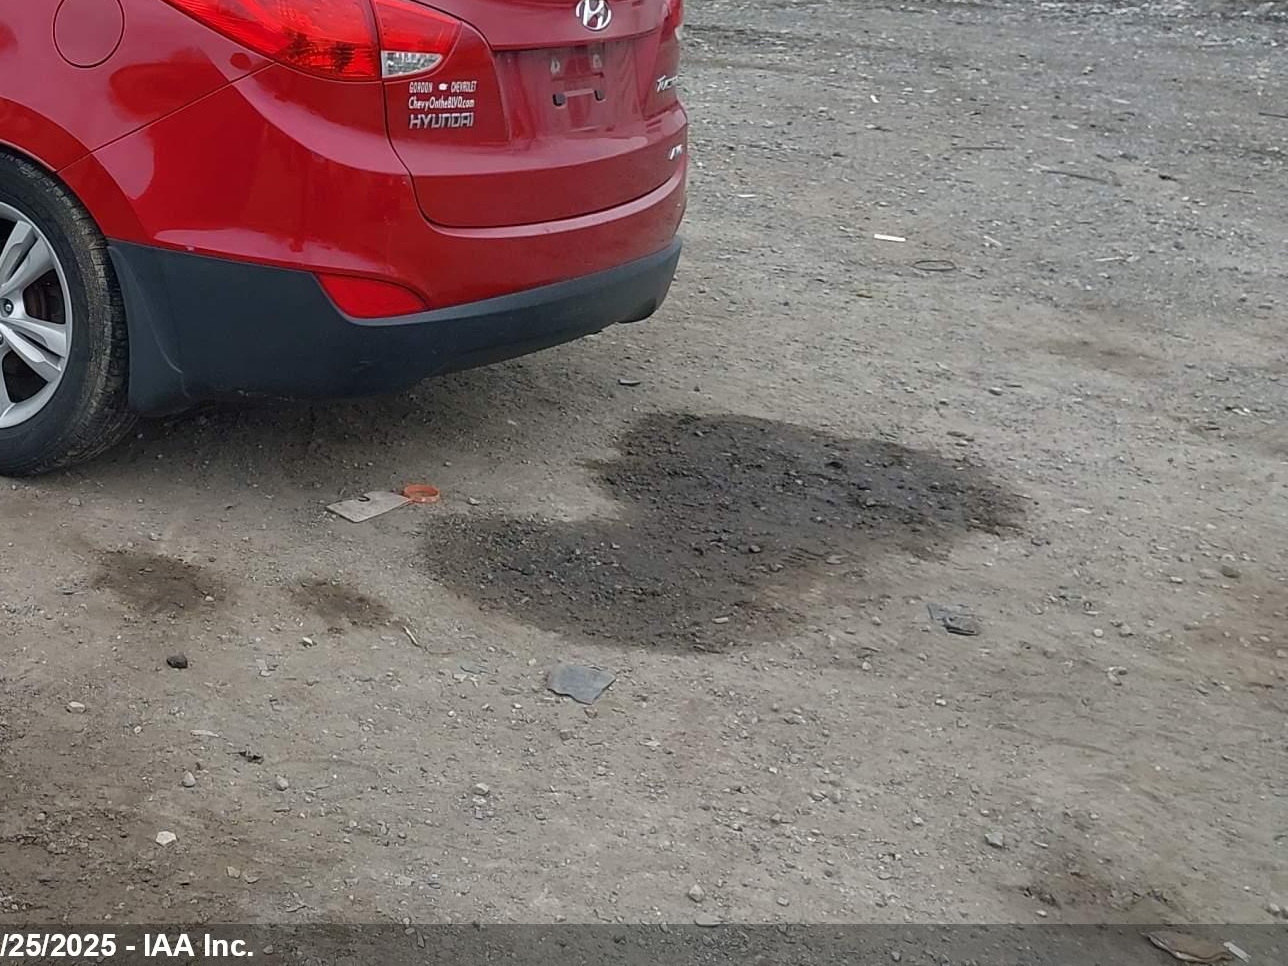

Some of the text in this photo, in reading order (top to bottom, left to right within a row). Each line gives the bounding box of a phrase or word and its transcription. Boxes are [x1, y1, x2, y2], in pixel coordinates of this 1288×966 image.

[409, 80, 477, 94] GORDON CHEVROLET
[409, 112, 474, 129] HYUNDAI
